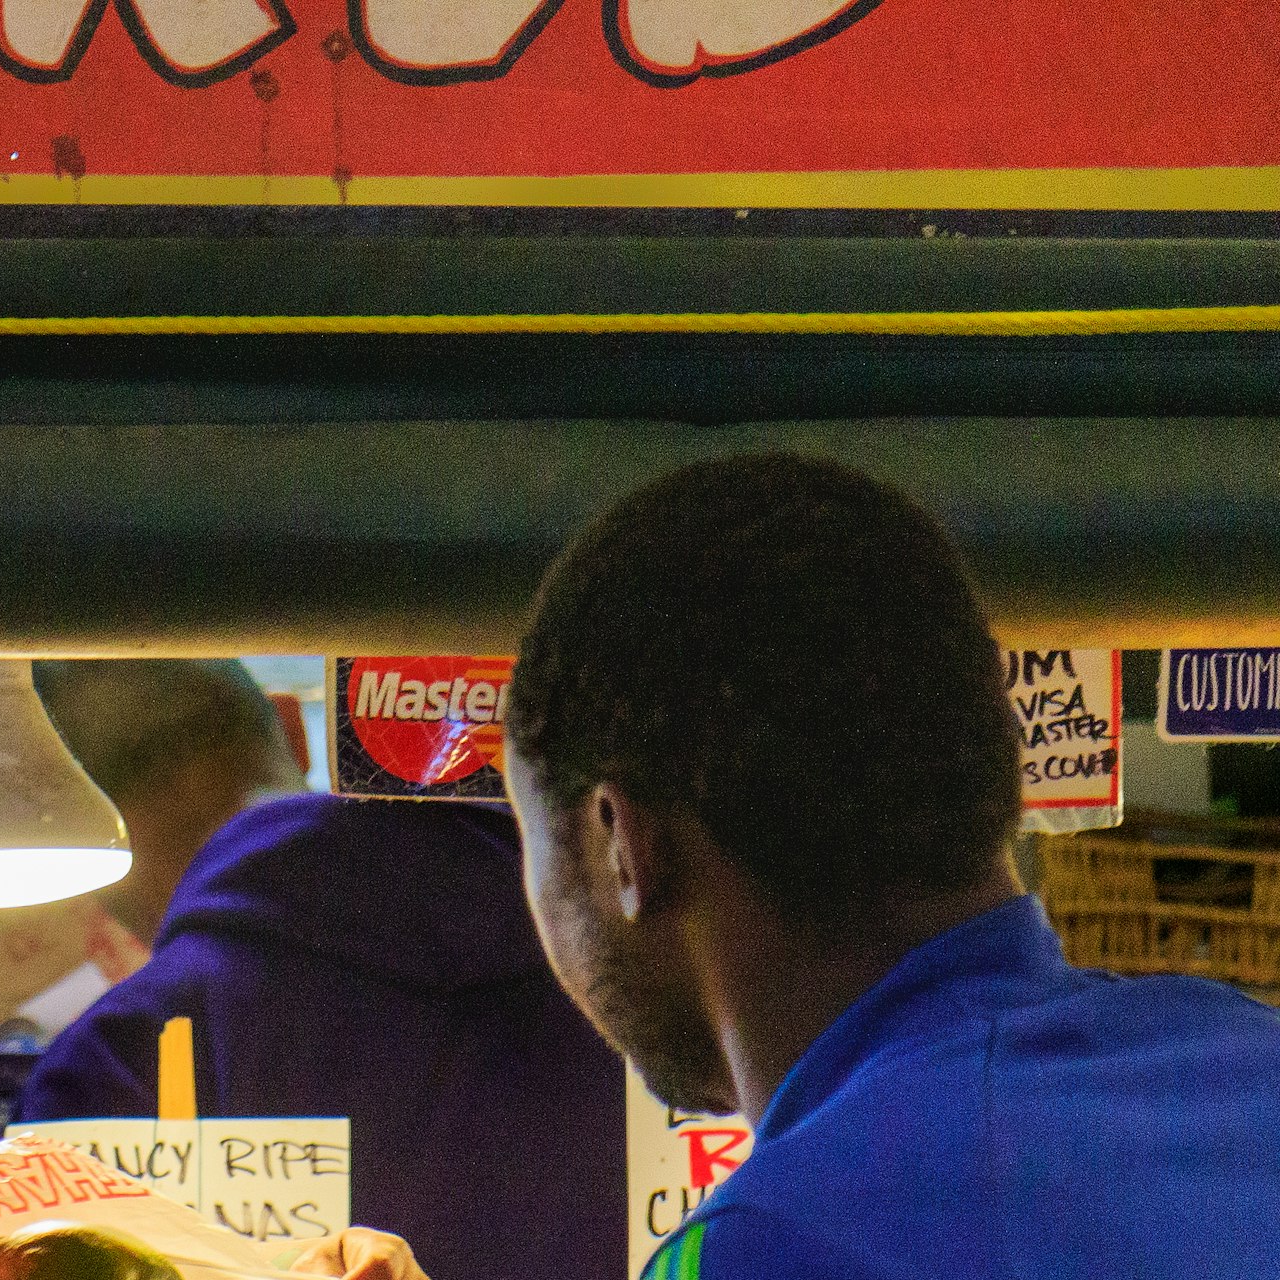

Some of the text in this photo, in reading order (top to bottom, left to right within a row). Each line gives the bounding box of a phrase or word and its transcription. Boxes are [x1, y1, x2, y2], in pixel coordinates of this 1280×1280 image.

[1017, 684, 1088, 721] VISA
[1021, 713, 1119, 748] ASTER
[220, 1137, 348, 1181] RIPE
